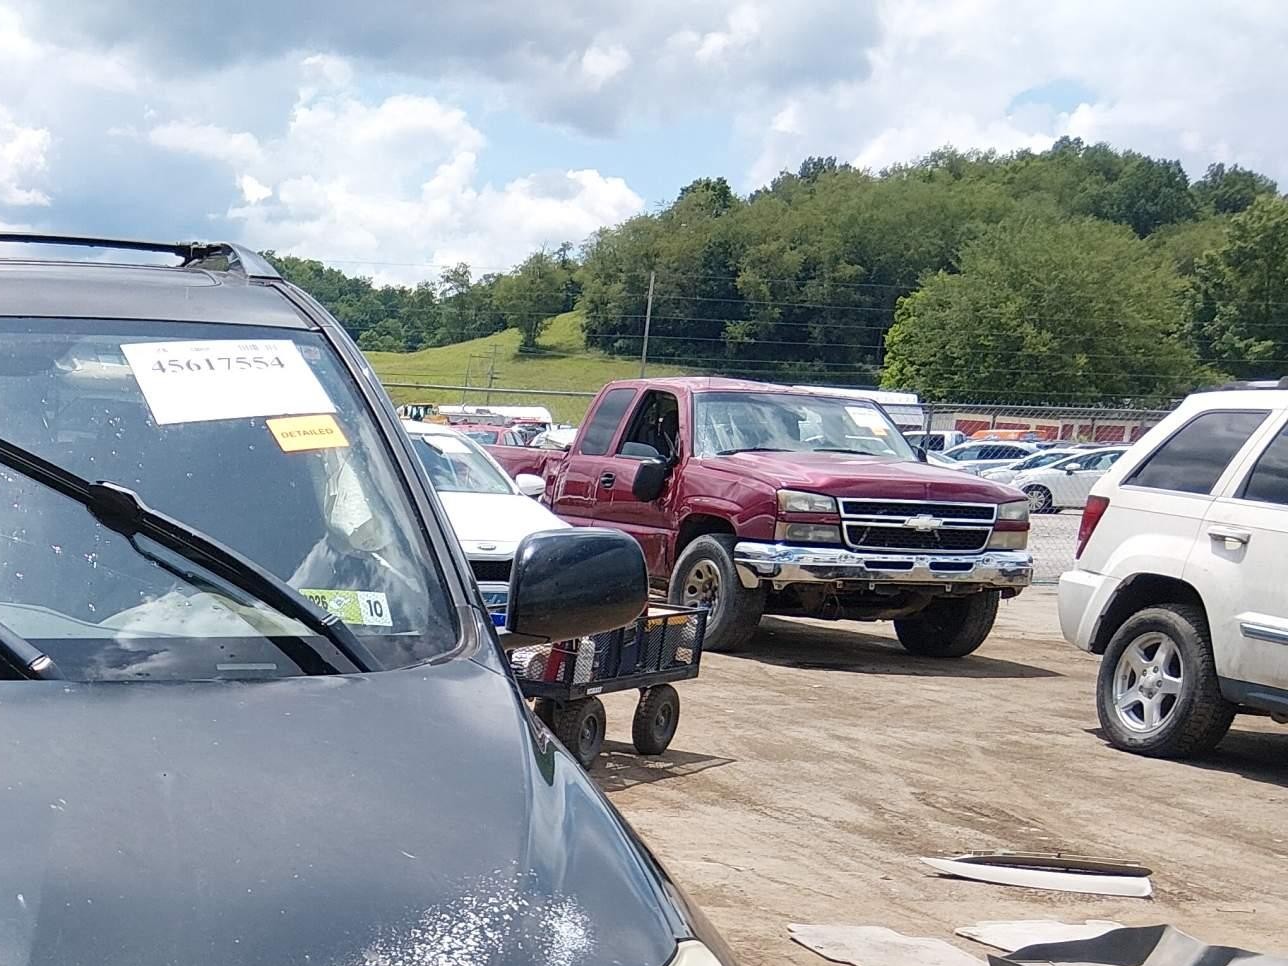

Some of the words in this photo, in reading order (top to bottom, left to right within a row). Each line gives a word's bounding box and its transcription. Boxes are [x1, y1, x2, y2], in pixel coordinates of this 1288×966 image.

[151, 355, 285, 374] 45617554
[281, 427, 334, 440] DETAILED
[366, 599, 383, 618] 10
